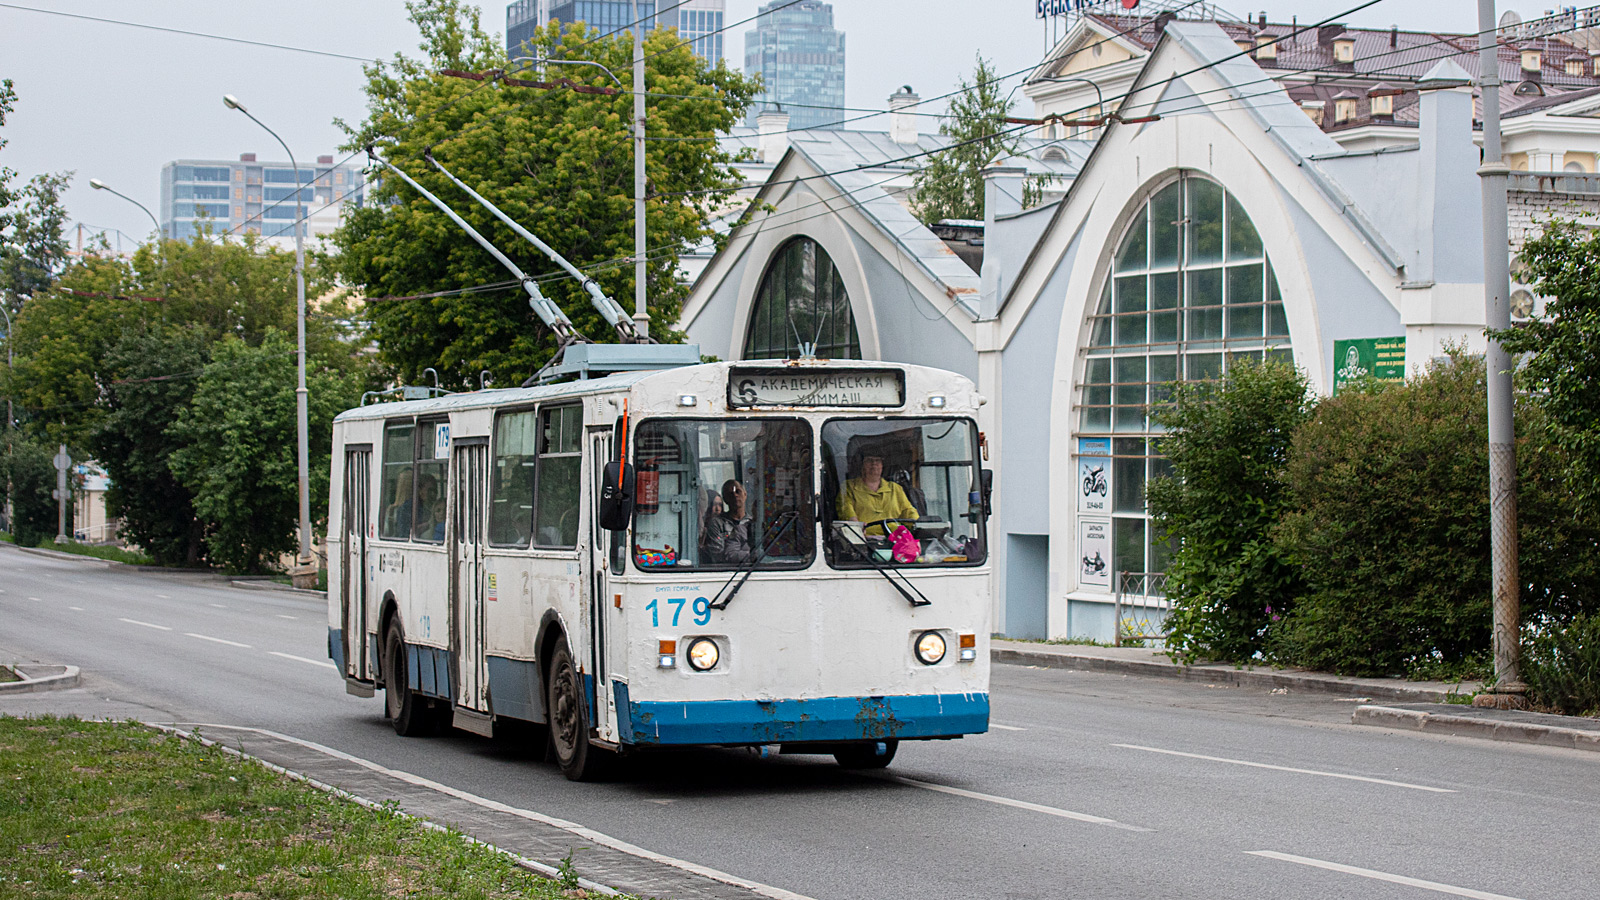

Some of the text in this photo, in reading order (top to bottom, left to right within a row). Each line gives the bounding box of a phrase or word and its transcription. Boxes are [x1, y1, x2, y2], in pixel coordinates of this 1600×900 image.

[738, 379, 757, 404] 6
[760, 376, 884, 391] АКАДЕМИЧЕСКАЯ
[797, 392, 861, 405] ХИММАШ
[437, 425, 450, 448] 179
[645, 596, 712, 628] 179
